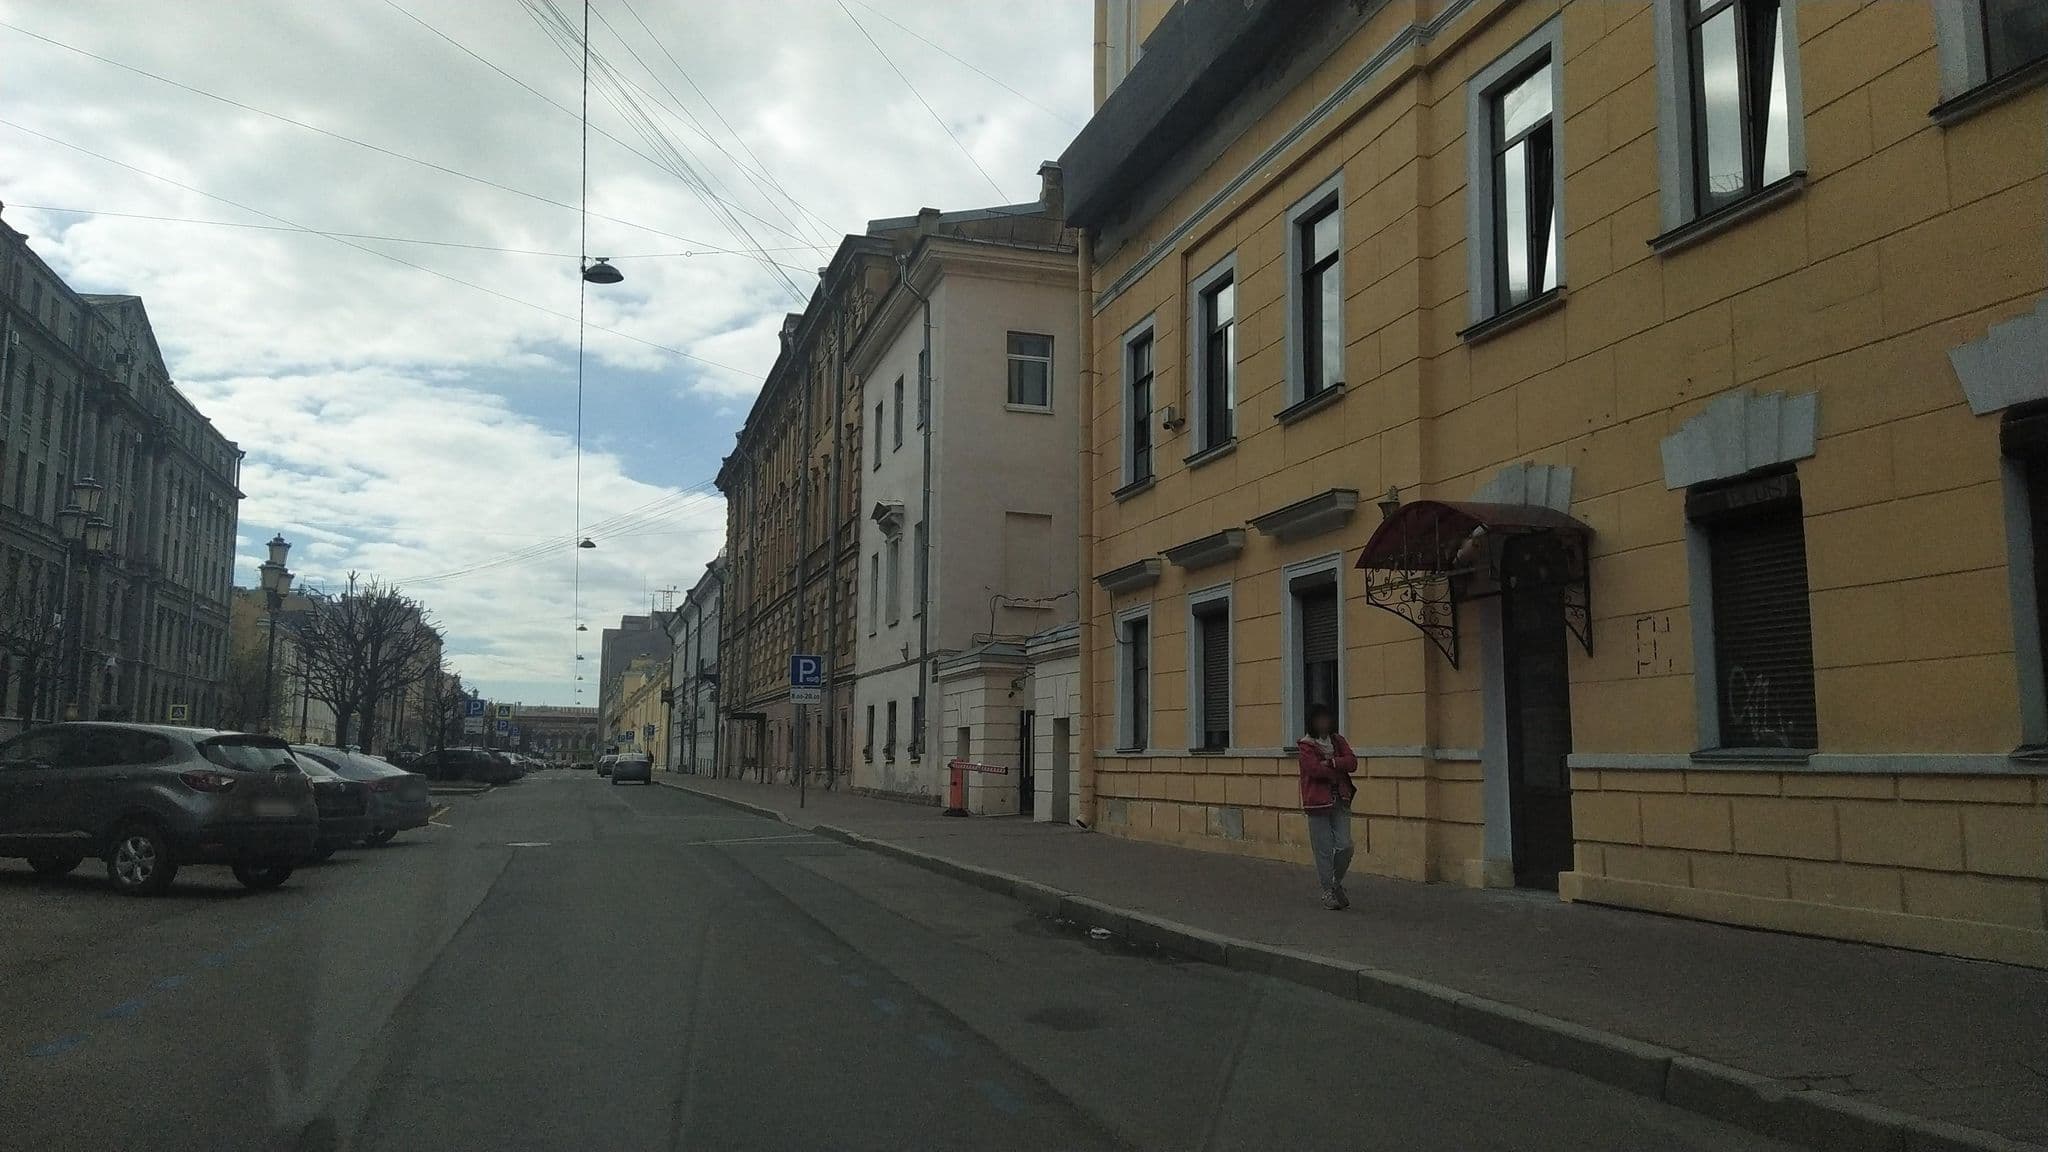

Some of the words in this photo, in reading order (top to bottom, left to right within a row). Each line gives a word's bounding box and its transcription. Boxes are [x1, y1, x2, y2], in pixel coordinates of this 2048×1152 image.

[800, 659, 816, 682] P
[471, 701, 481, 714] P
[500, 721, 507, 729] P
